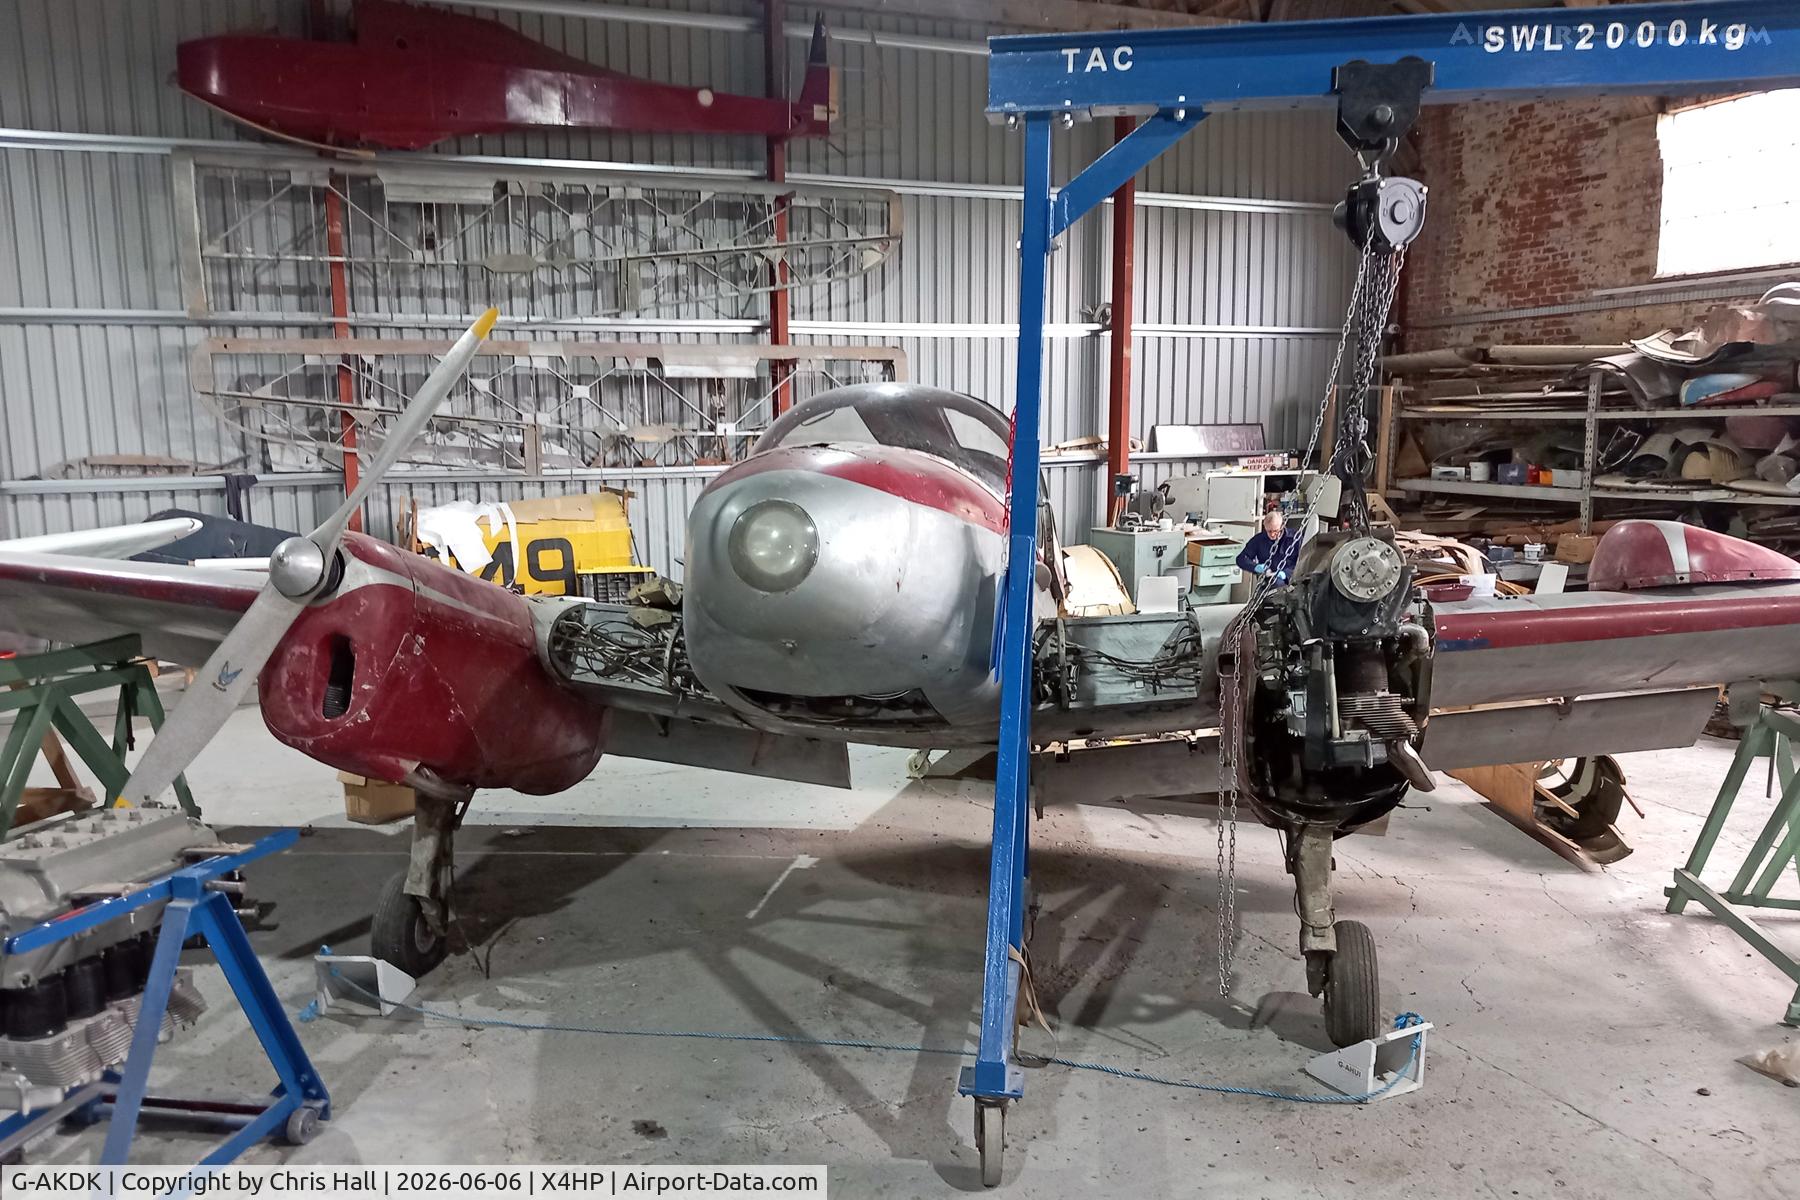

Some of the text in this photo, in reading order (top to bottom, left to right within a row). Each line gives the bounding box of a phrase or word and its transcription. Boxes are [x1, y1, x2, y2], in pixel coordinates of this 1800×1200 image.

[1483, 23, 1563, 53] SWL
[1061, 45, 1133, 74] TAC
[1247, 457, 1274, 465] DANGER
